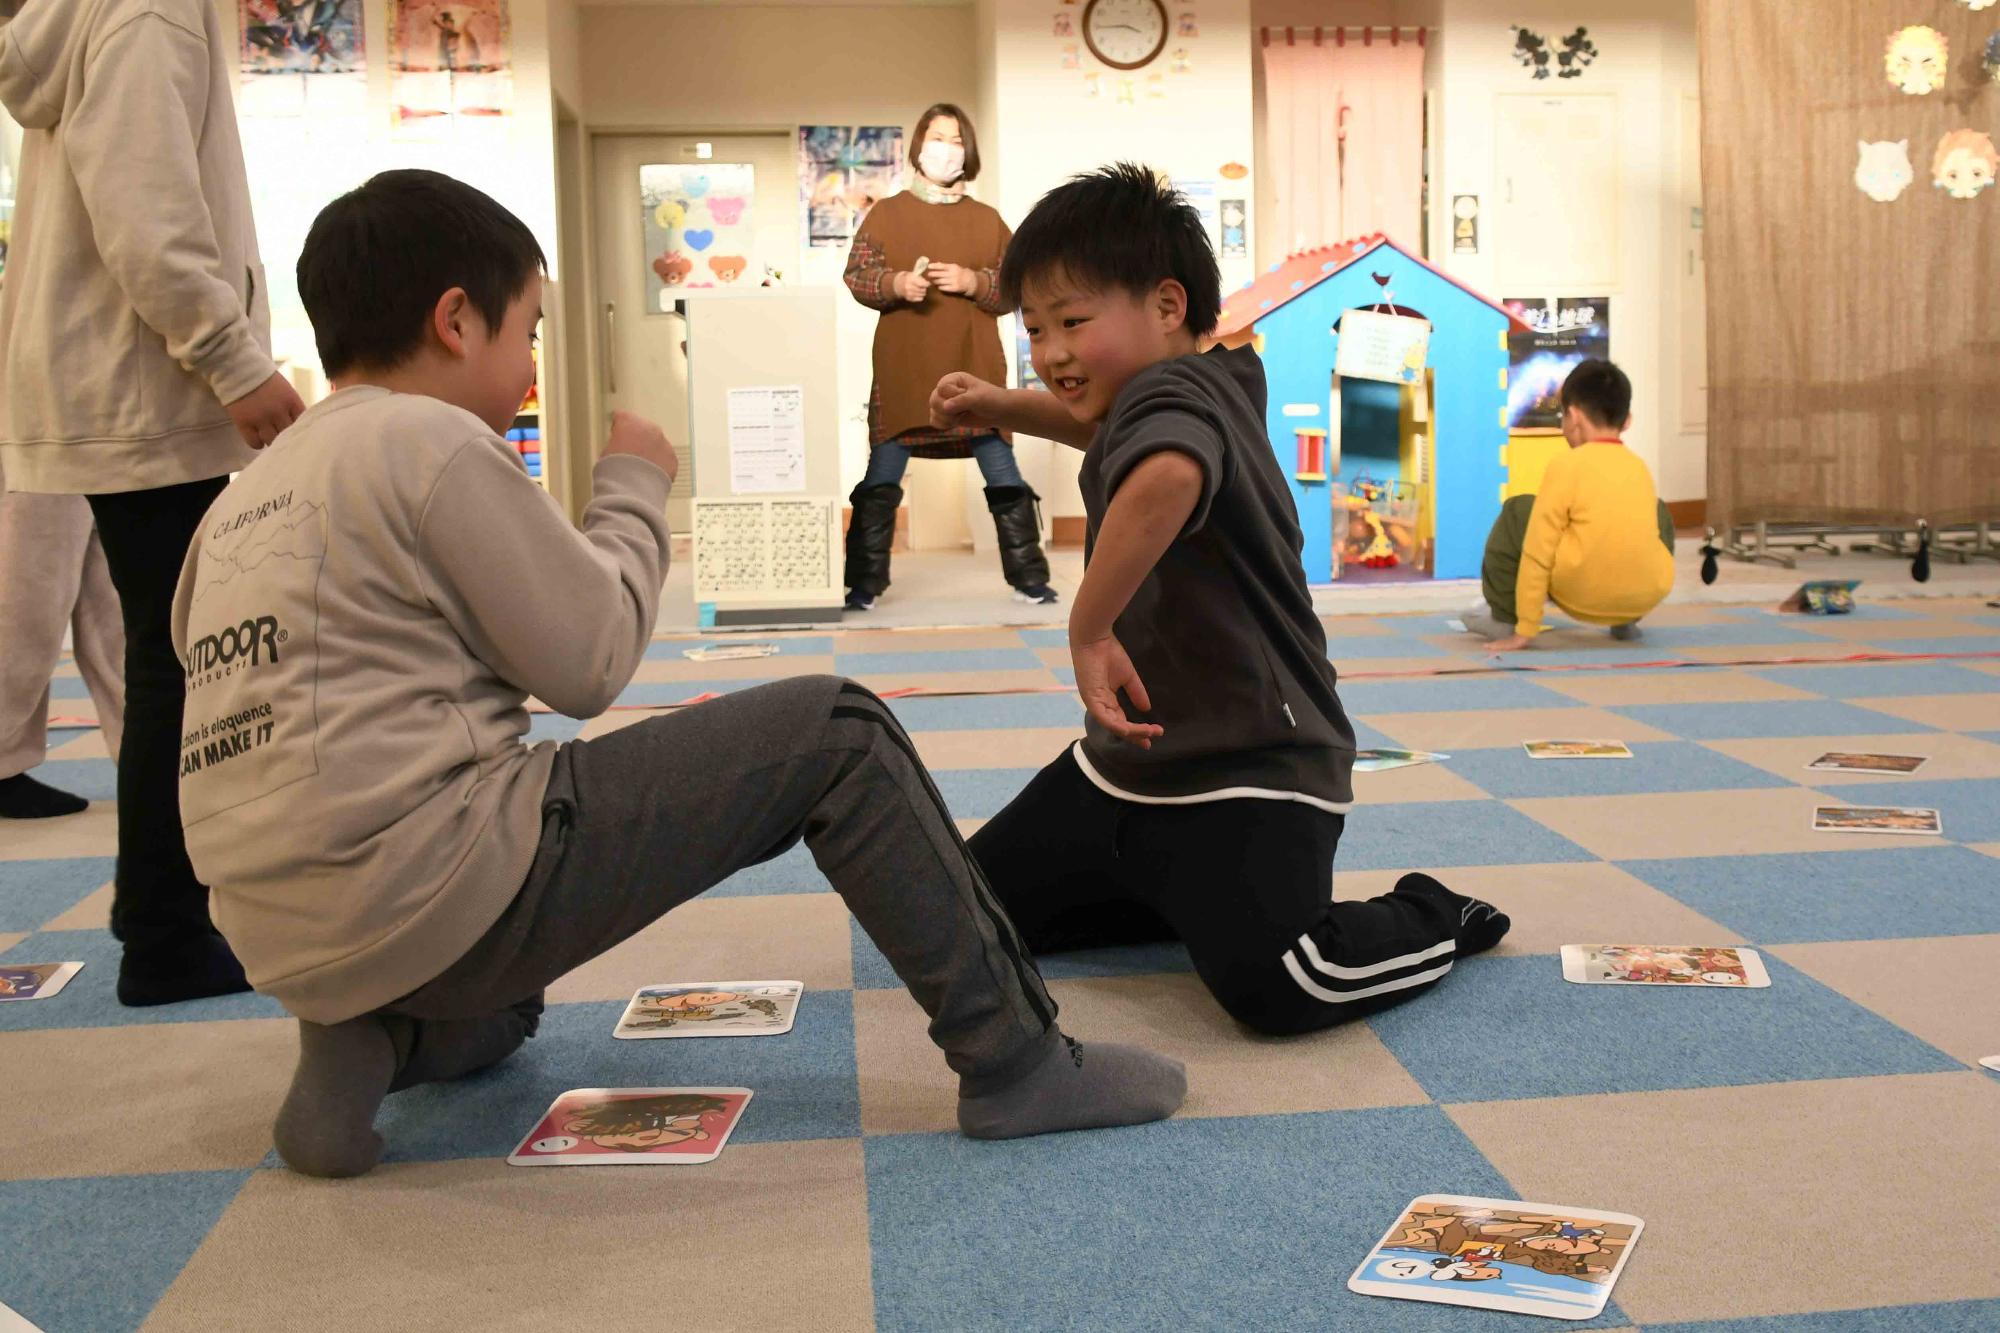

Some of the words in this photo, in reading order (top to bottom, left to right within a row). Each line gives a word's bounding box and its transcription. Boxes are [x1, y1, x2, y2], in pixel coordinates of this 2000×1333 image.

[201, 723, 209, 740] is
[211, 702, 273, 733] eloquence
[203, 728, 252, 767] MAKE
[256, 721, 275, 747] IT
[1391, 1261, 1418, 1277] ら
